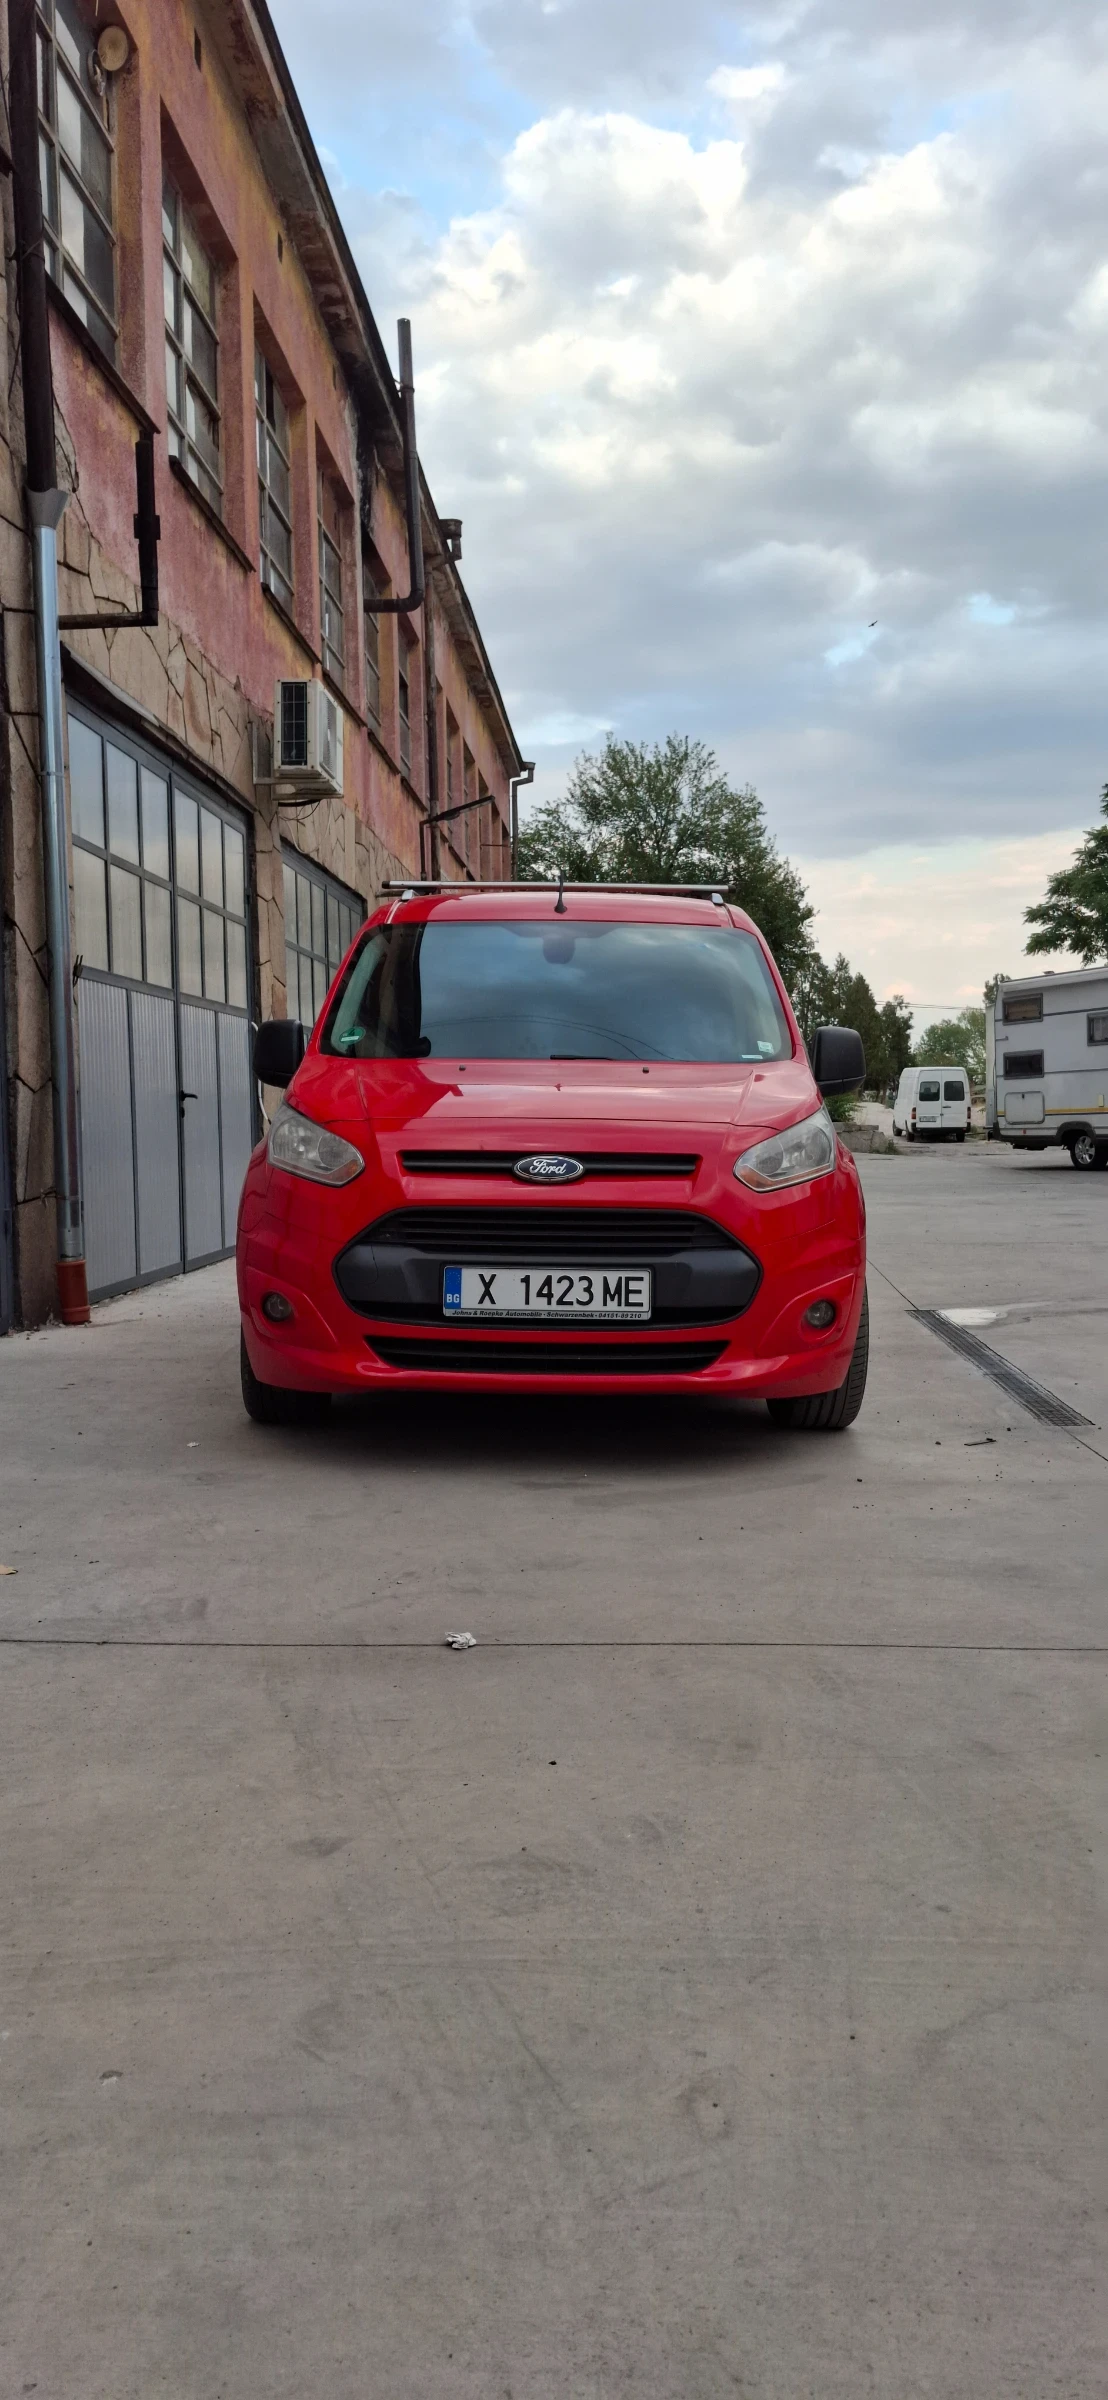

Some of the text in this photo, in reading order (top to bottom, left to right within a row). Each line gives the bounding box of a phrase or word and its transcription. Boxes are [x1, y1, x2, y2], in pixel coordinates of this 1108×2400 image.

[529, 1159, 567, 1174] Ford
[477, 1273, 644, 1308] X 1423 ME
[446, 1294, 460, 1303] BG
